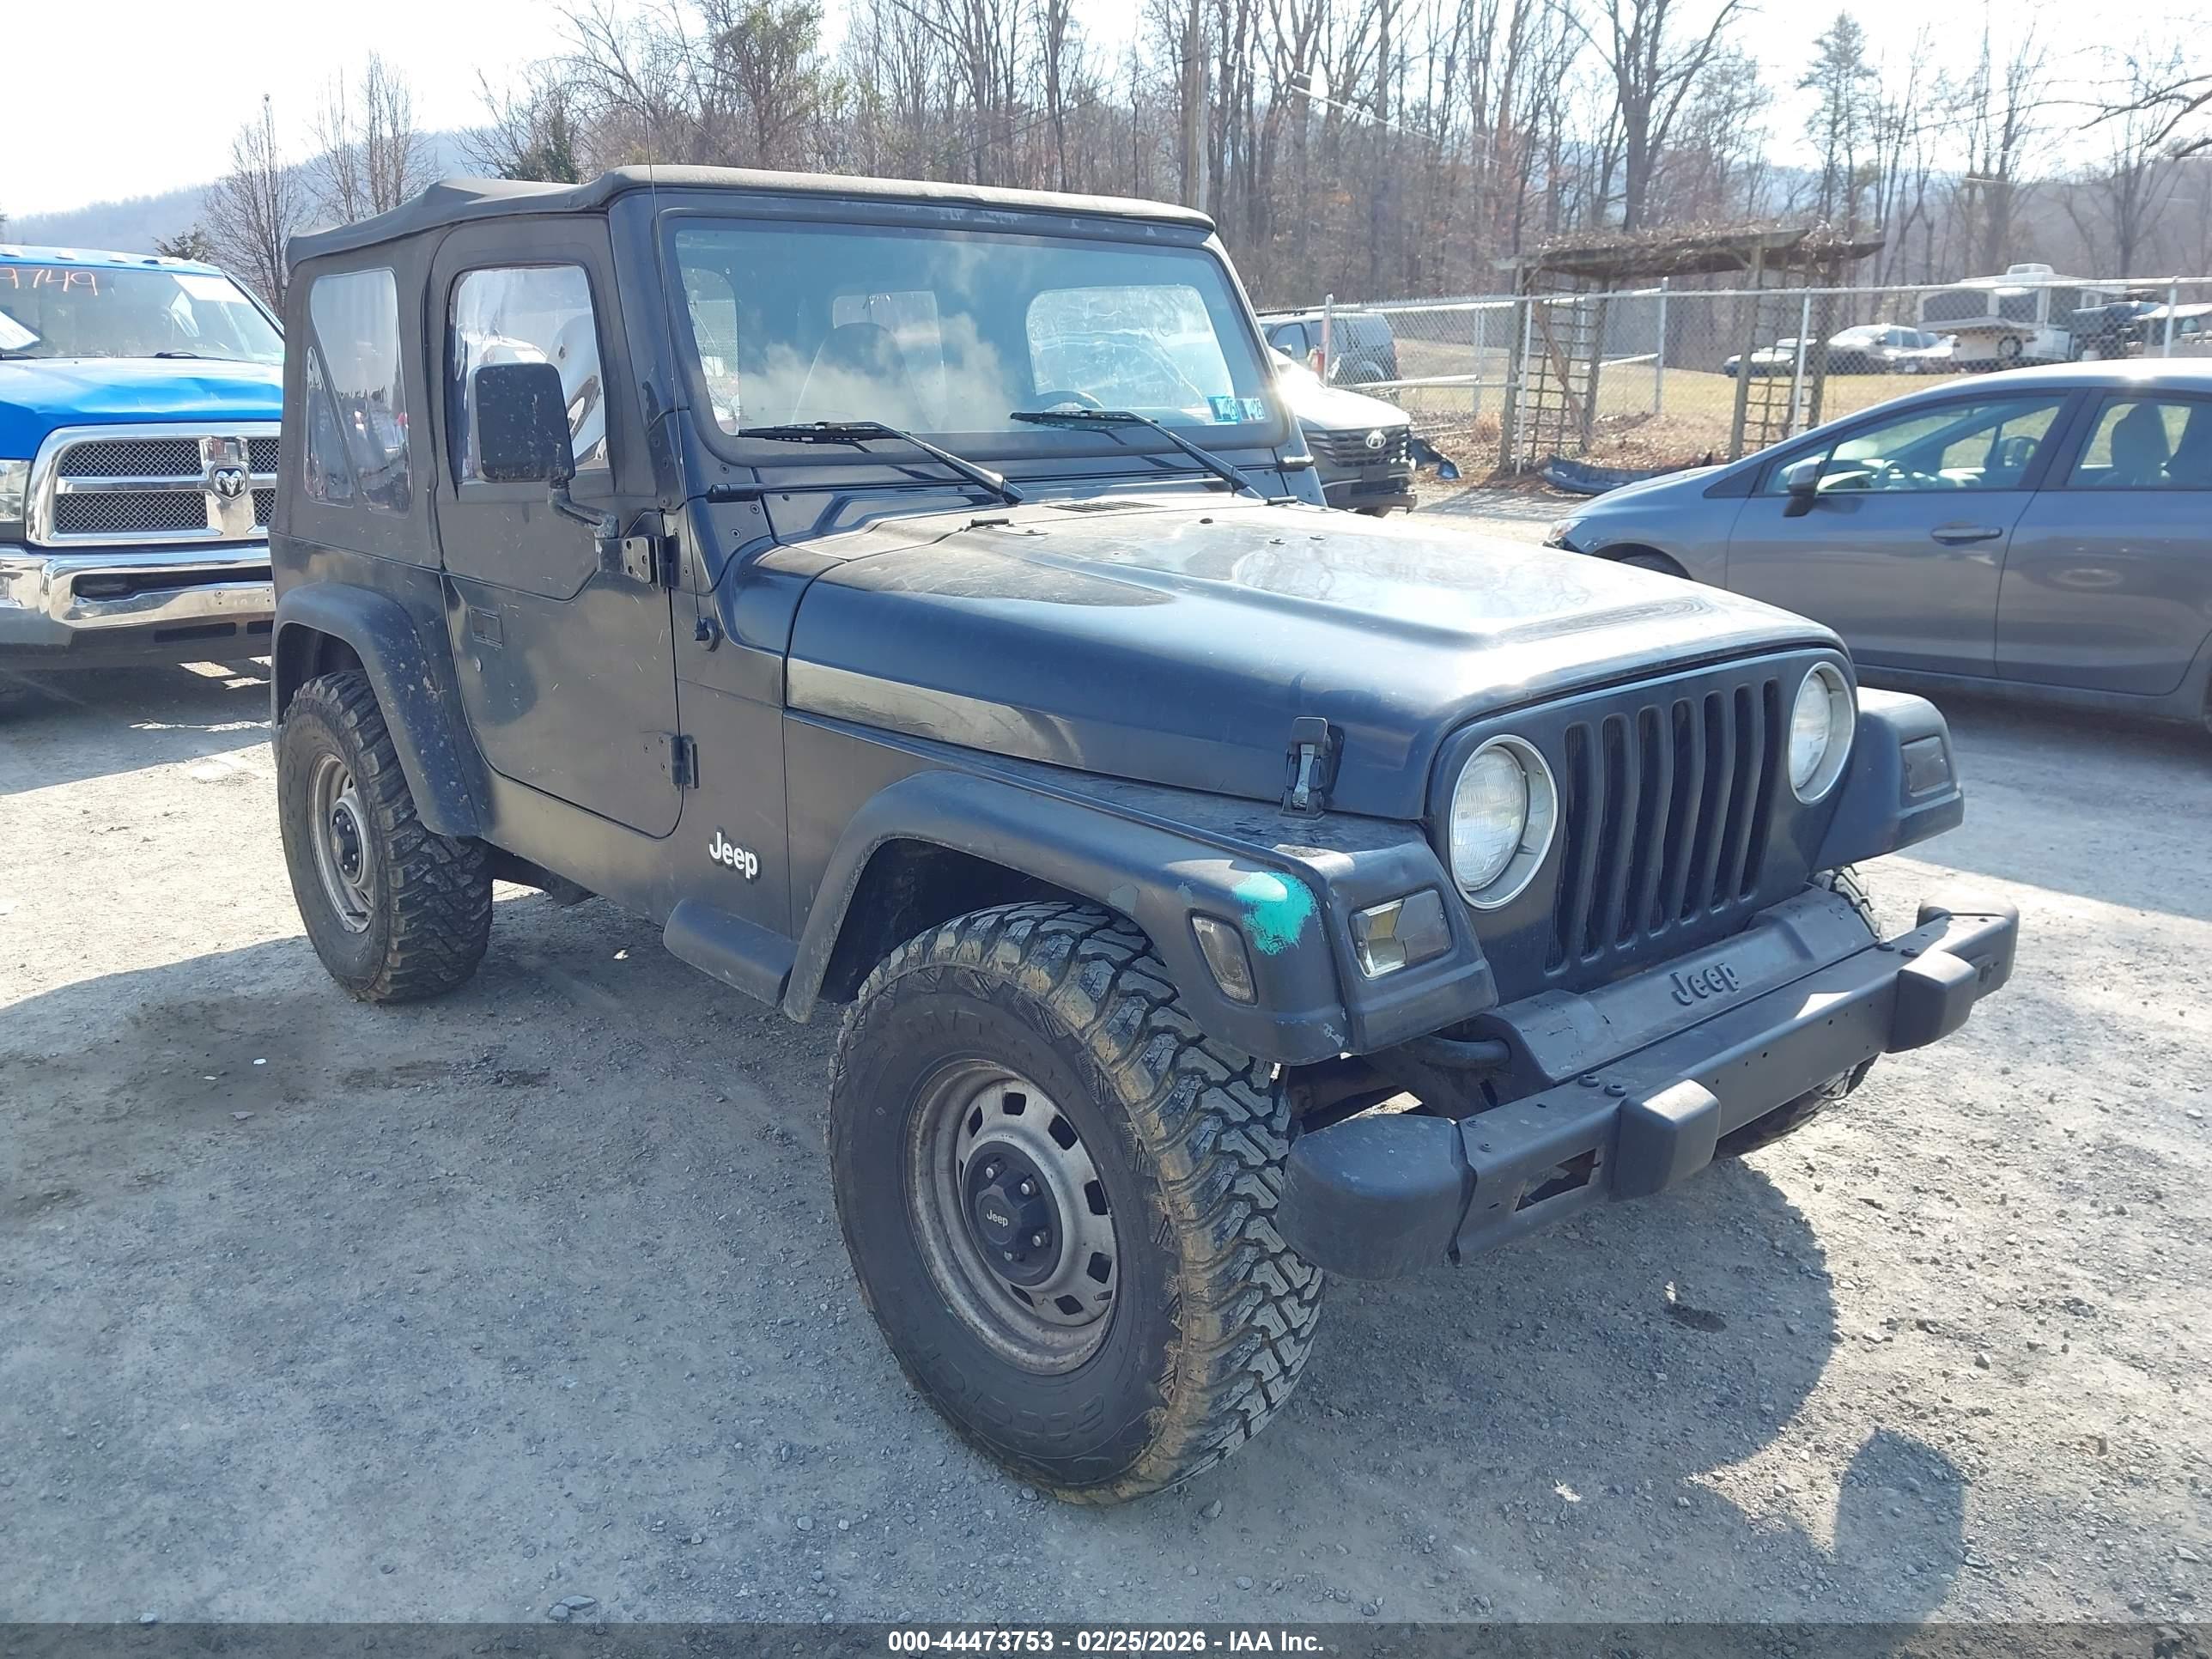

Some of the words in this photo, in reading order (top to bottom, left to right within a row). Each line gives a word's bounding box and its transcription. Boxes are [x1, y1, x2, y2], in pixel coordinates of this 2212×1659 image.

[708, 831, 758, 879] Jeep
[1670, 963, 1739, 1006] Jeep
[986, 1209, 1009, 1228] Jeep
